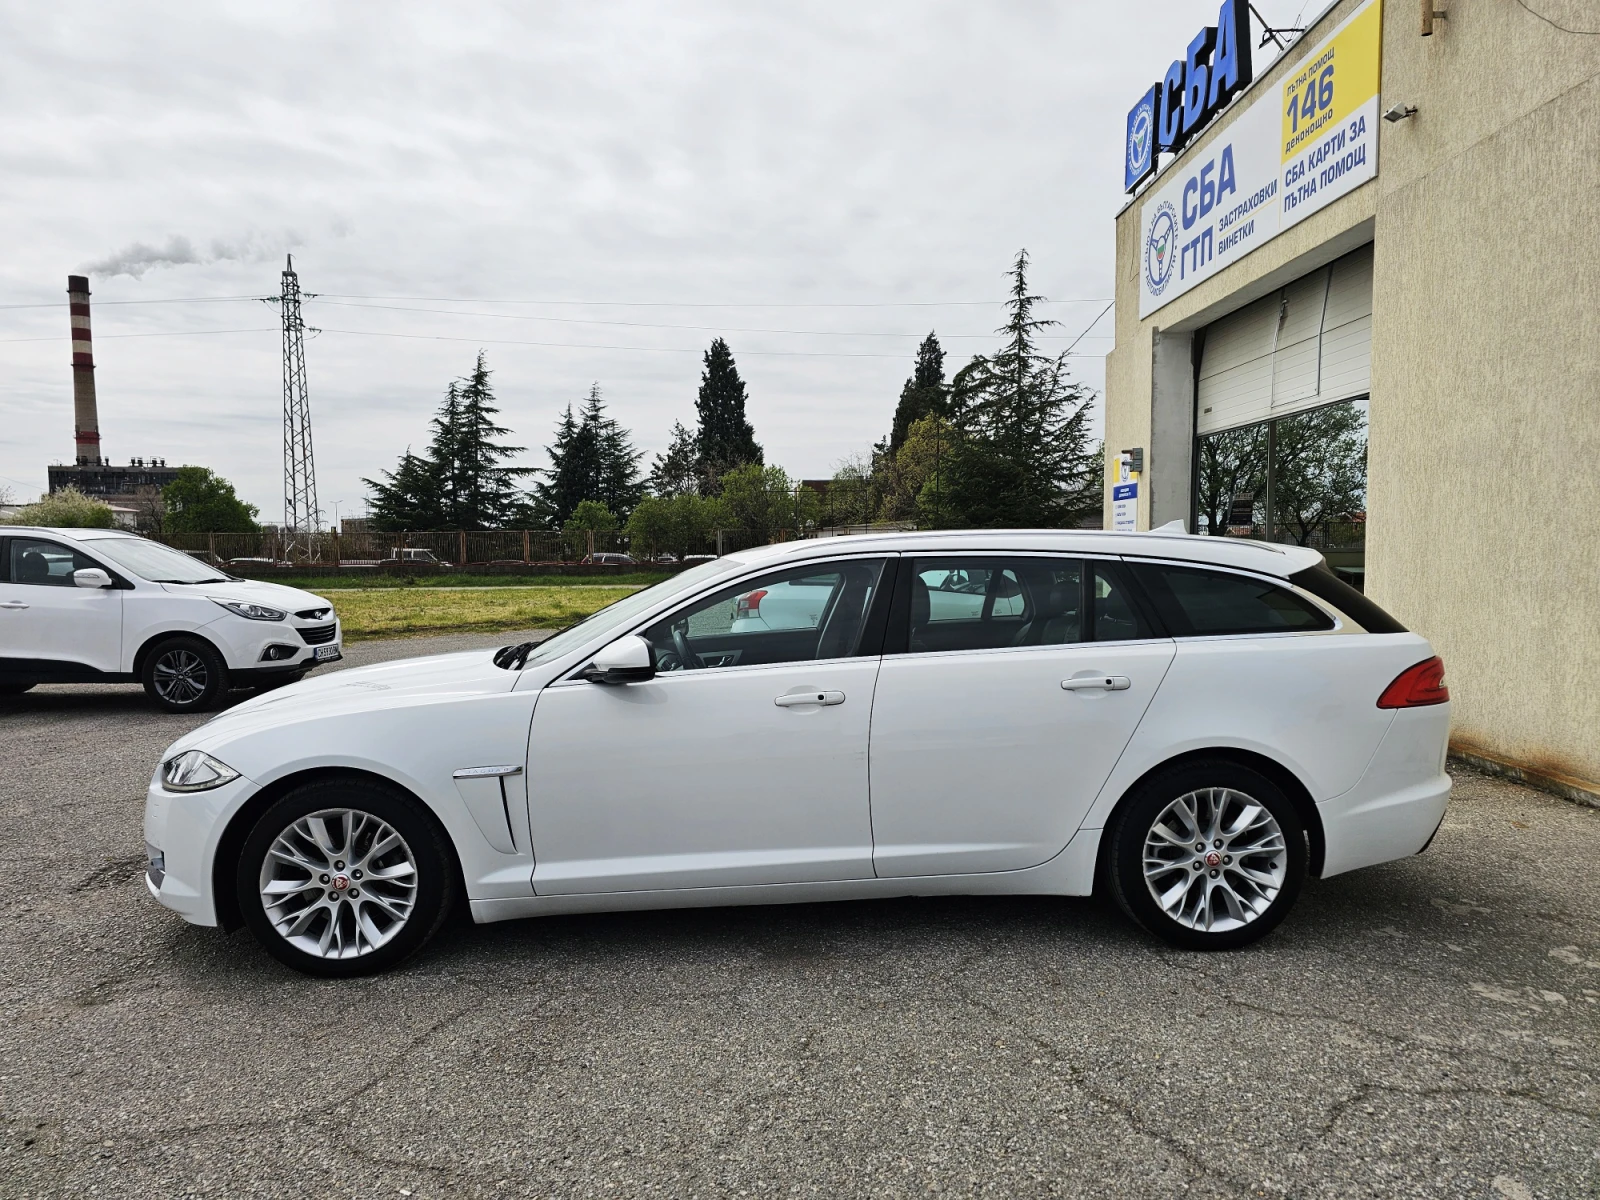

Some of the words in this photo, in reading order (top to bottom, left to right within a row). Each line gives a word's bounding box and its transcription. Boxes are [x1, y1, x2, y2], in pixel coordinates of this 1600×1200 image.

[1159, 0, 1239, 152] СБА
[1286, 64, 1335, 134] 146
[1287, 72, 1307, 97] ПЪТНА
[1309, 46, 1335, 78] ПОМОЩ
[1285, 108, 1333, 155] денонощно
[1285, 160, 1305, 188] СБА
[1308, 129, 1346, 173] КАРТИ
[1349, 115, 1366, 143] ЗА
[1182, 143, 1236, 231] СБА
[1219, 178, 1278, 232] ЗАСТРАХОВКИ
[1284, 178, 1317, 213] ПЪТНА
[1320, 143, 1366, 190] ПОМОЩ
[1180, 225, 1214, 281] ГТП
[1218, 219, 1255, 255] ВИНЕТКИ
